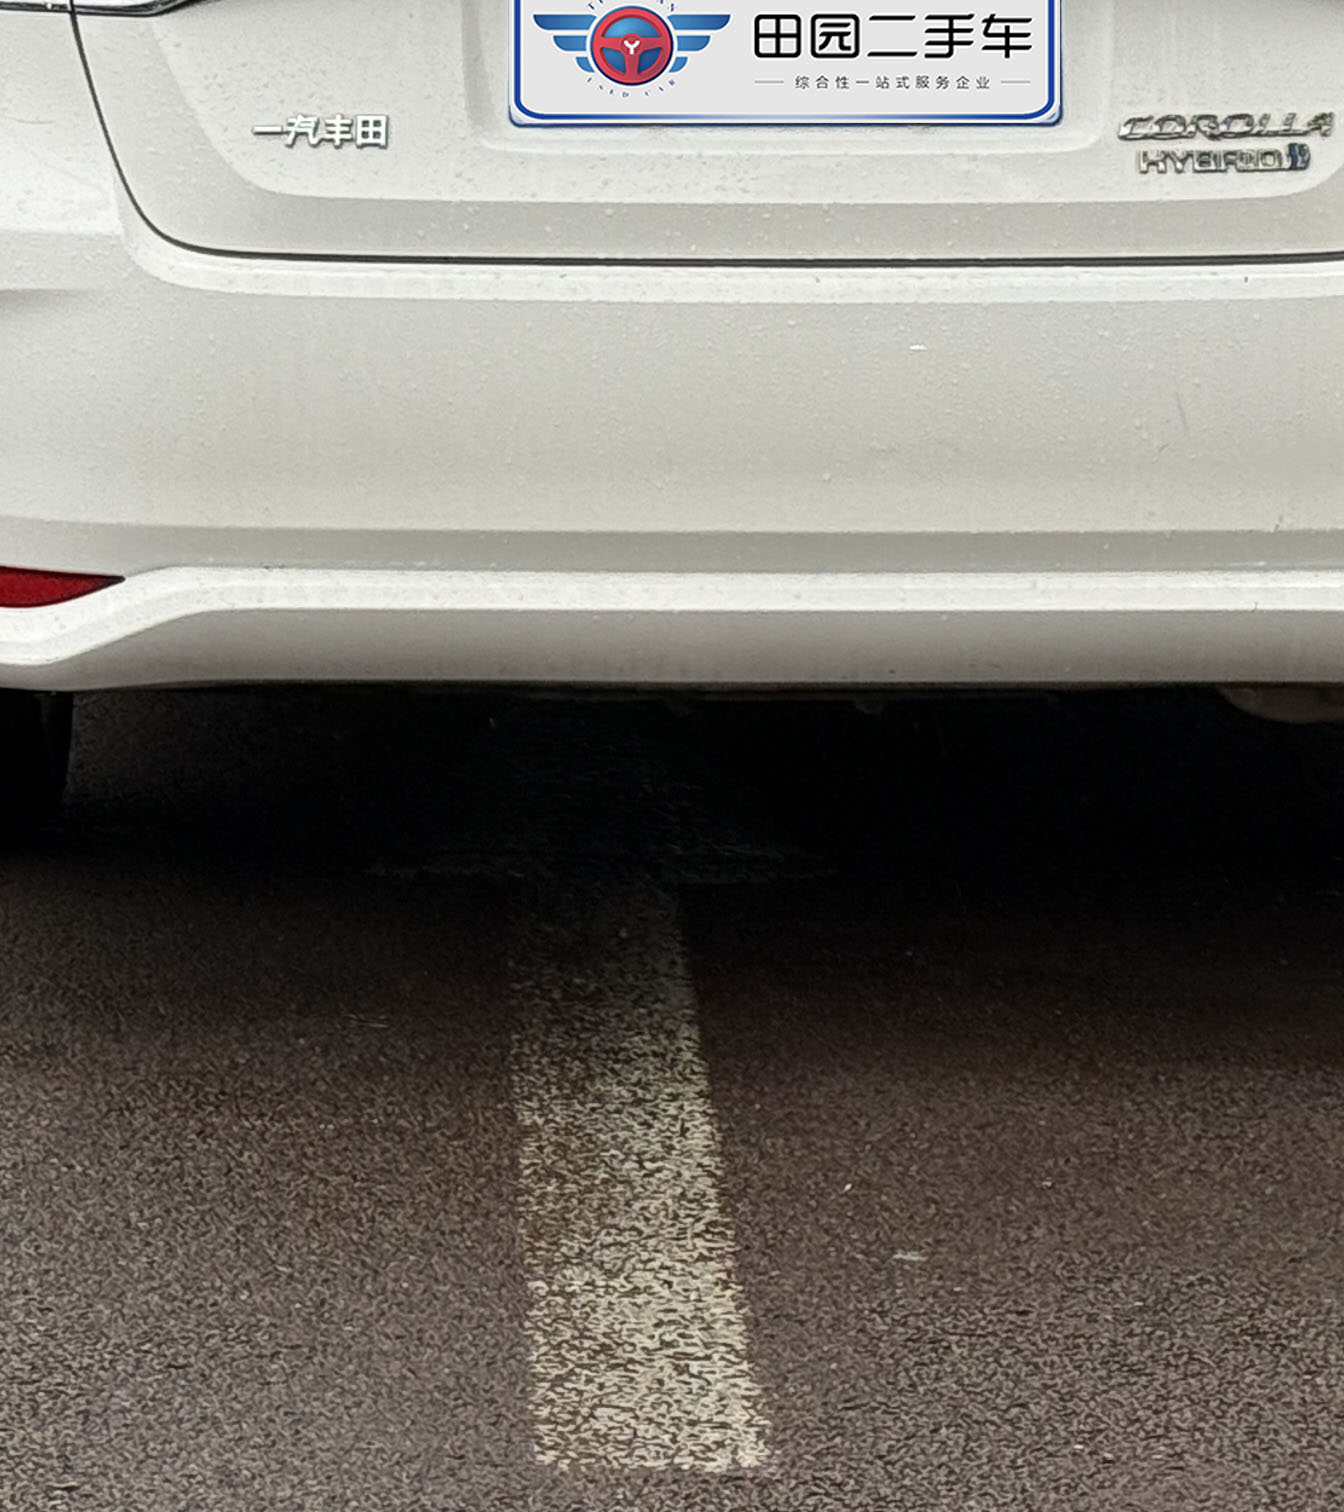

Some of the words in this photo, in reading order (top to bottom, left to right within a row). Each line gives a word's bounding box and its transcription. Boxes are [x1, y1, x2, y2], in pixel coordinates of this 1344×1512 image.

[252, 113, 390, 150] 一汽丰田
[1117, 112, 1336, 141] COROLLA
[1136, 148, 1284, 174] HYBRID
